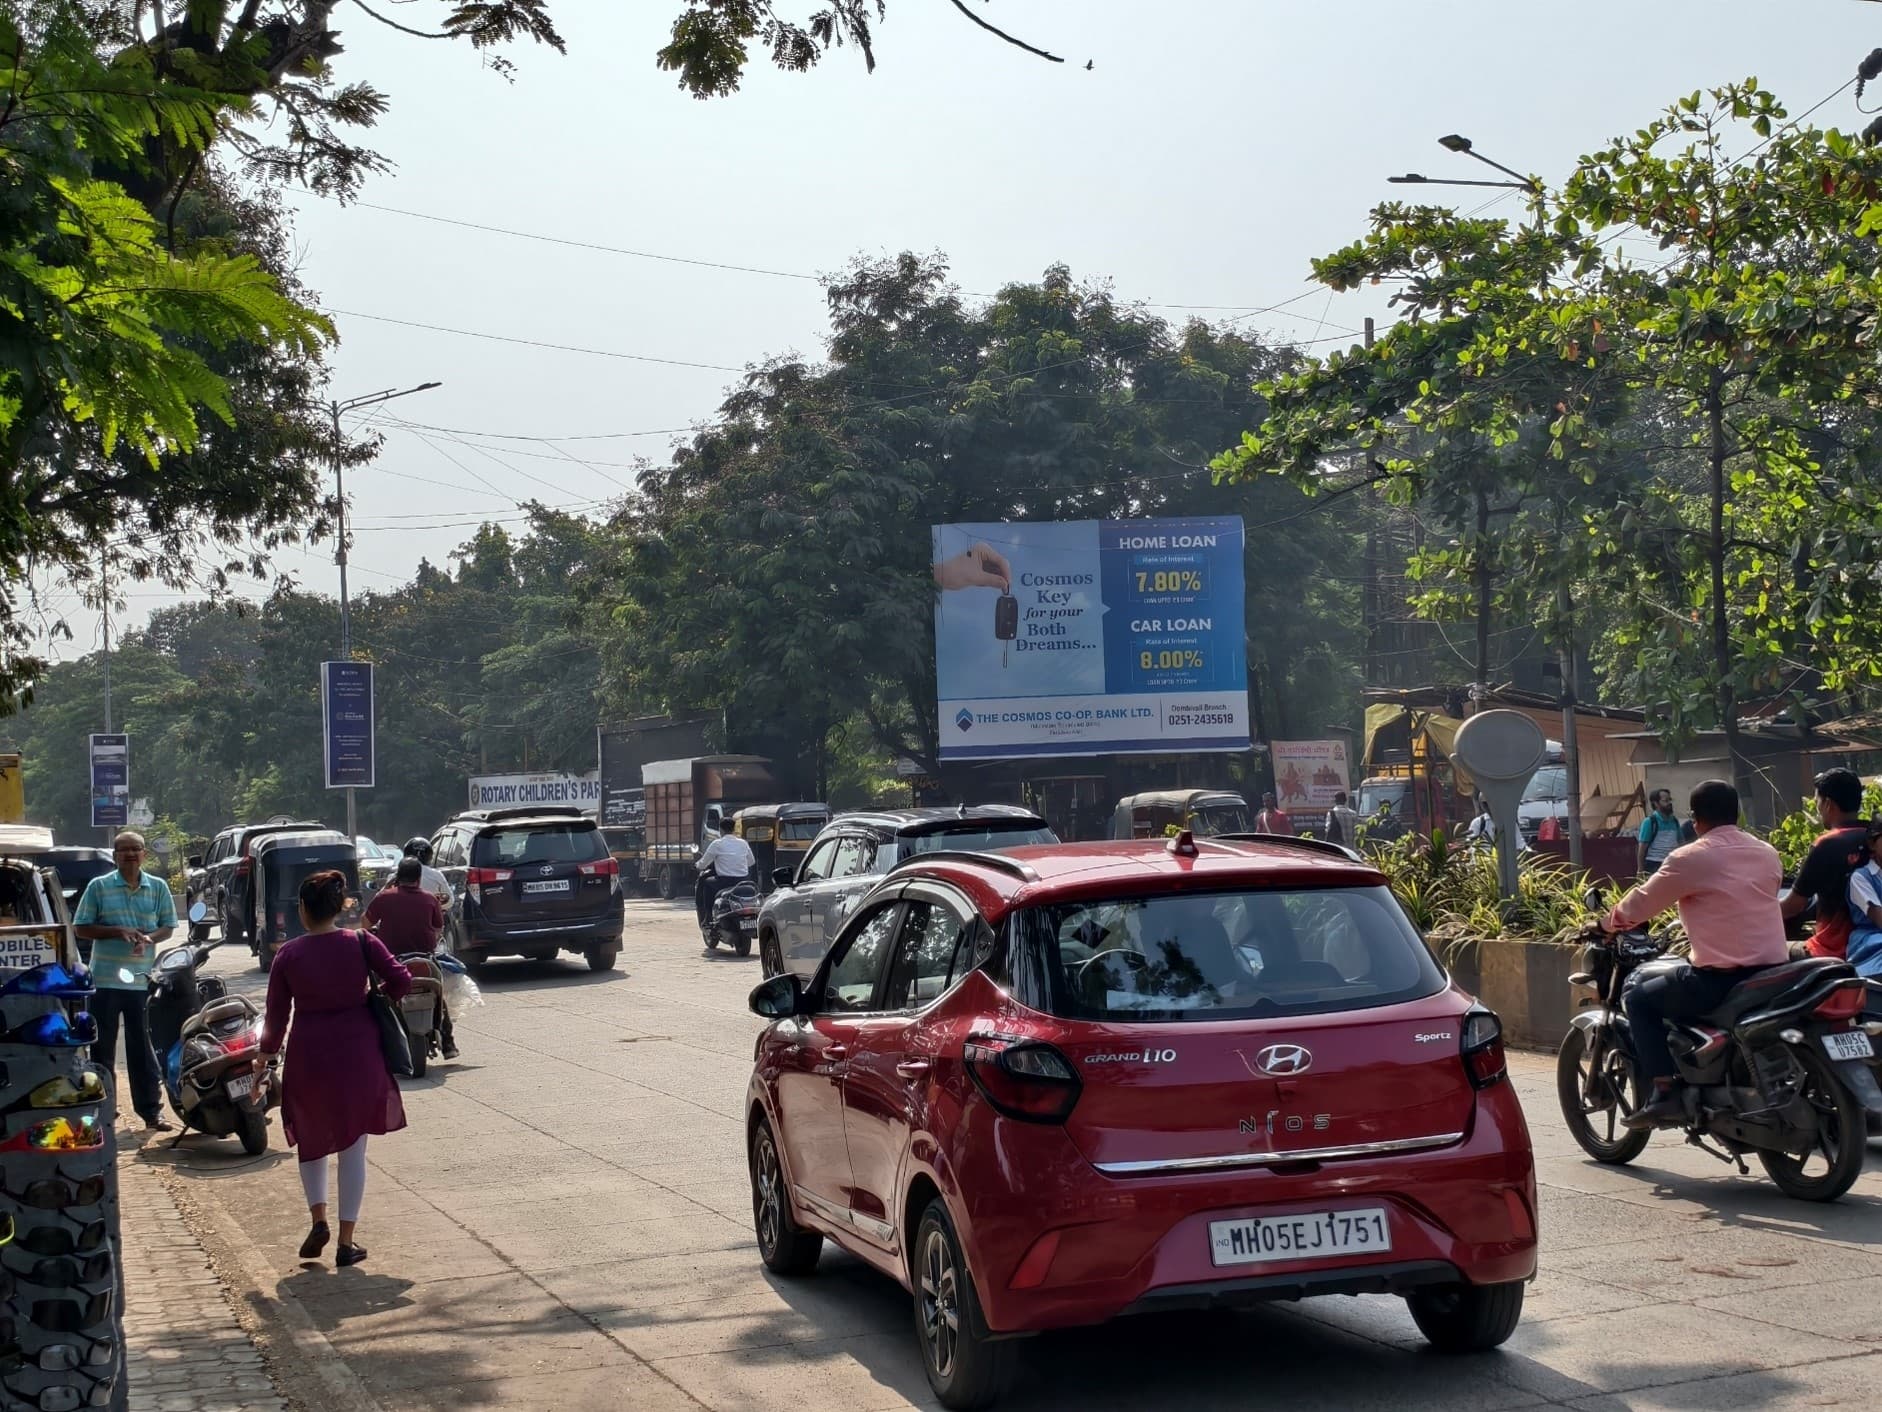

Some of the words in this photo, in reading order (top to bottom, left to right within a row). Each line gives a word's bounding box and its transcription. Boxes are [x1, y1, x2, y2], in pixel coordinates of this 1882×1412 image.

[1119, 537, 1167, 549] HOME
[1172, 535, 1216, 548] LOAN
[1021, 573, 1093, 587] Cosmos
[1036, 590, 1072, 606] Key
[1023, 607, 1046, 621] for
[1050, 608, 1083, 620] your
[1027, 622, 1066, 636] Both
[1131, 619, 1162, 632] CAR
[1167, 618, 1212, 631] LOAN
[1016, 639, 1096, 651] Dreams...
[1204, 703, 1227, 711] Branch
[976, 713, 999, 723] THE
[1002, 711, 1052, 722] COSMOS
[1096, 708, 1127, 719] BANK
[1130, 707, 1154, 718] LTD.
[1168, 713, 1234, 726] 0251-2435618
[481, 784, 517, 803] ROTARY
[519, 780, 577, 802] CHILDREN'S
[1414, 1032, 1452, 1042] Sportz
[1084, 1052, 1140, 1063] GRAND
[1143, 1048, 1177, 1063] i10
[1230, 1214, 1385, 1255] MH05EJ1751
